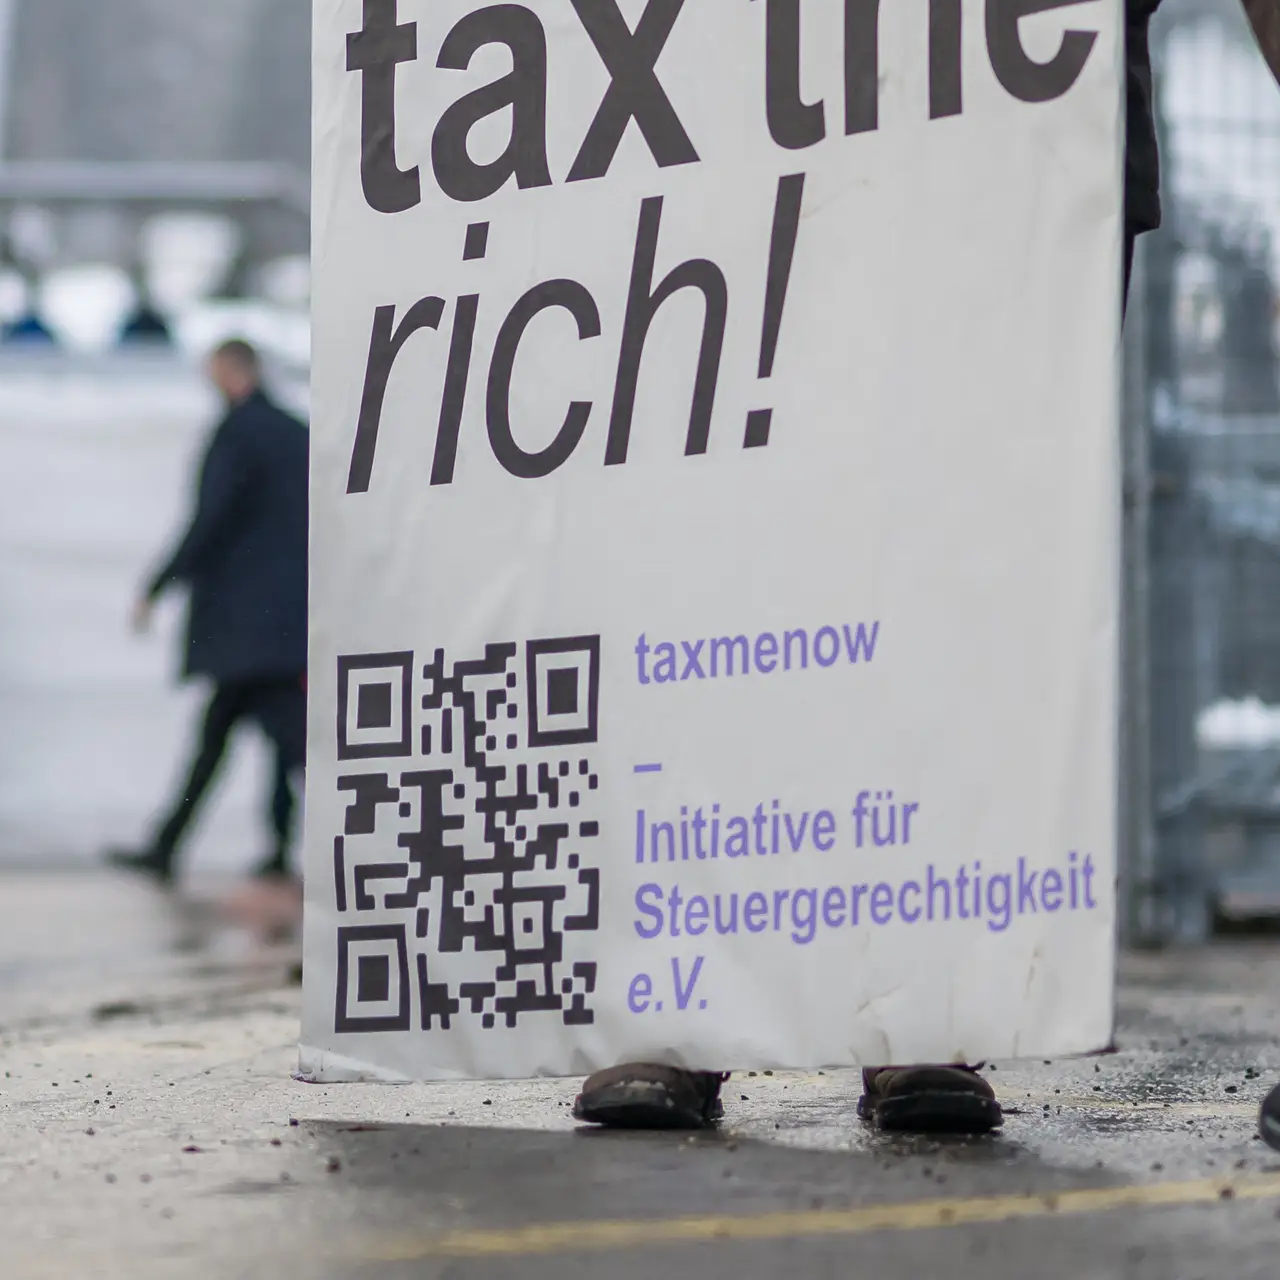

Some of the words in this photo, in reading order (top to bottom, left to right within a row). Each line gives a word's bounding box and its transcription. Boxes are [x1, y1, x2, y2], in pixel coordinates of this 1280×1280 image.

[345, 173, 807, 495] rich!
[634, 620, 880, 686] taxmenow
[634, 799, 836, 864] Initiative
[851, 789, 919, 849] für
[633, 851, 1097, 945] Steuergerechtigkeit
[626, 956, 708, 1015] e.V.
